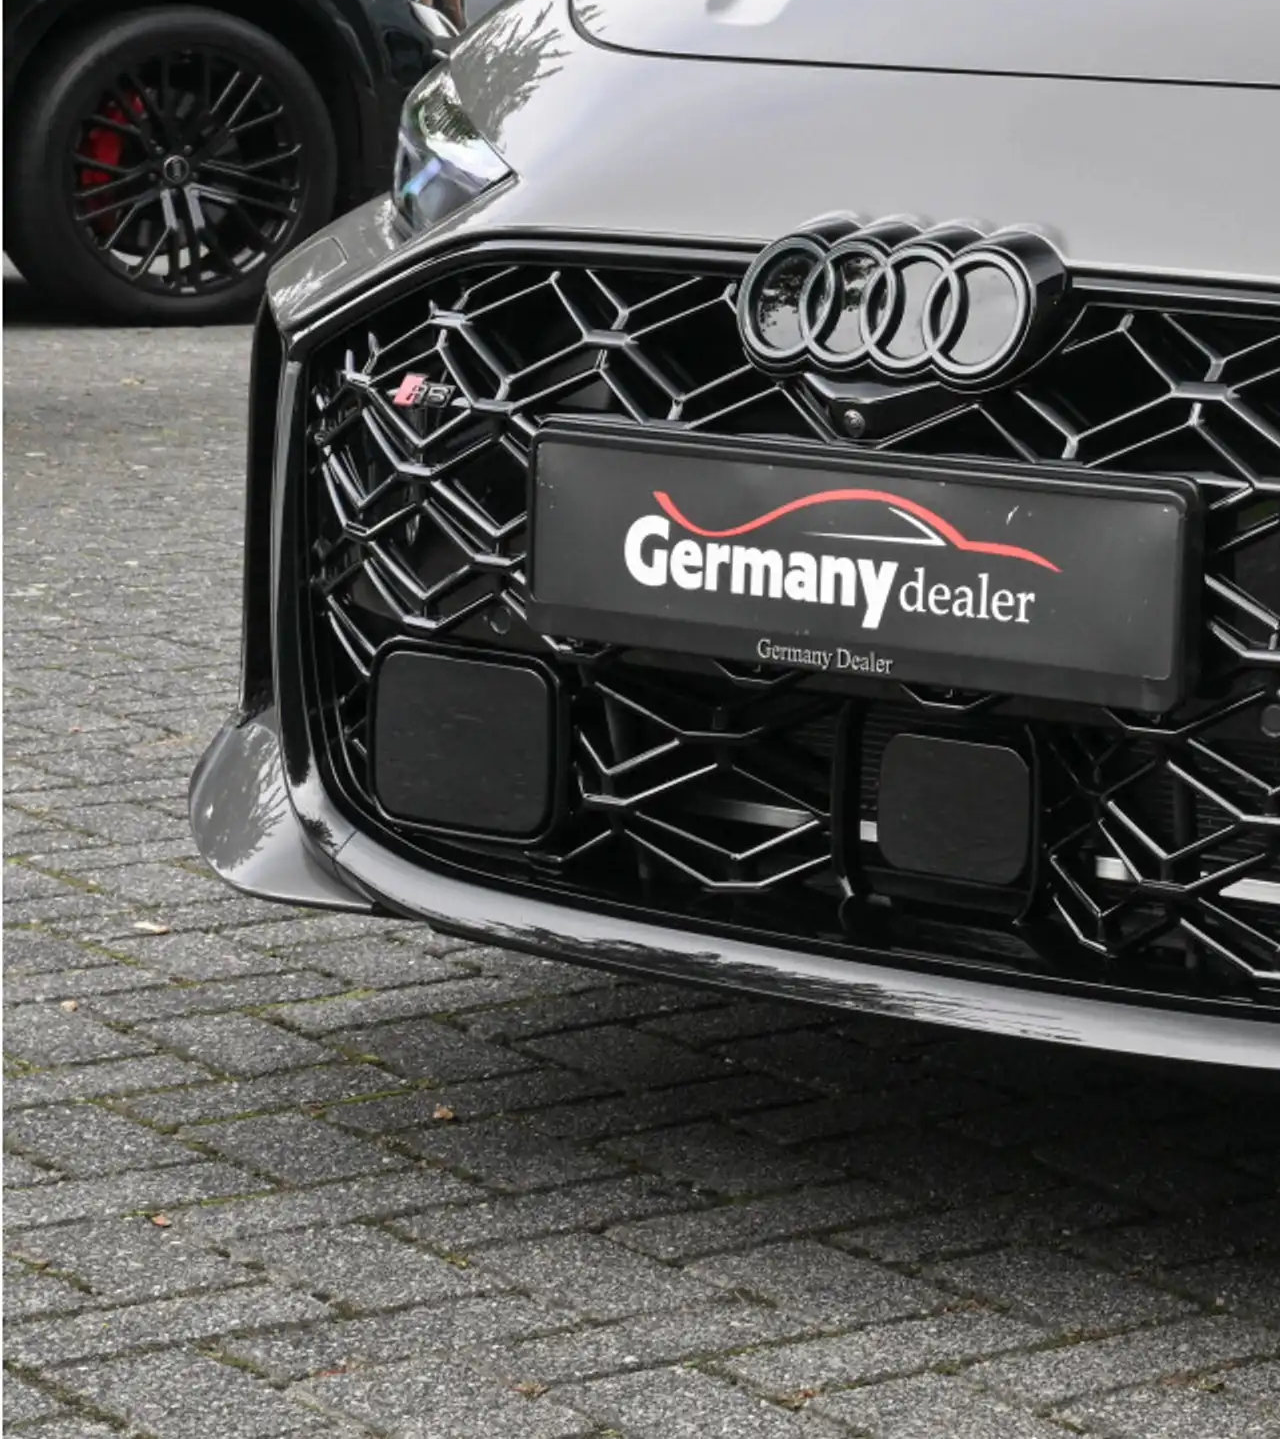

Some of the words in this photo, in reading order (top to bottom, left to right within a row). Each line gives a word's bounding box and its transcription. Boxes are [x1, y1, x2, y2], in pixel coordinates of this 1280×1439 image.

[624, 514, 899, 629] Germany
[899, 566, 1036, 624] dealer
[756, 638, 833, 670] Germany
[836, 647, 893, 674] Dealer
